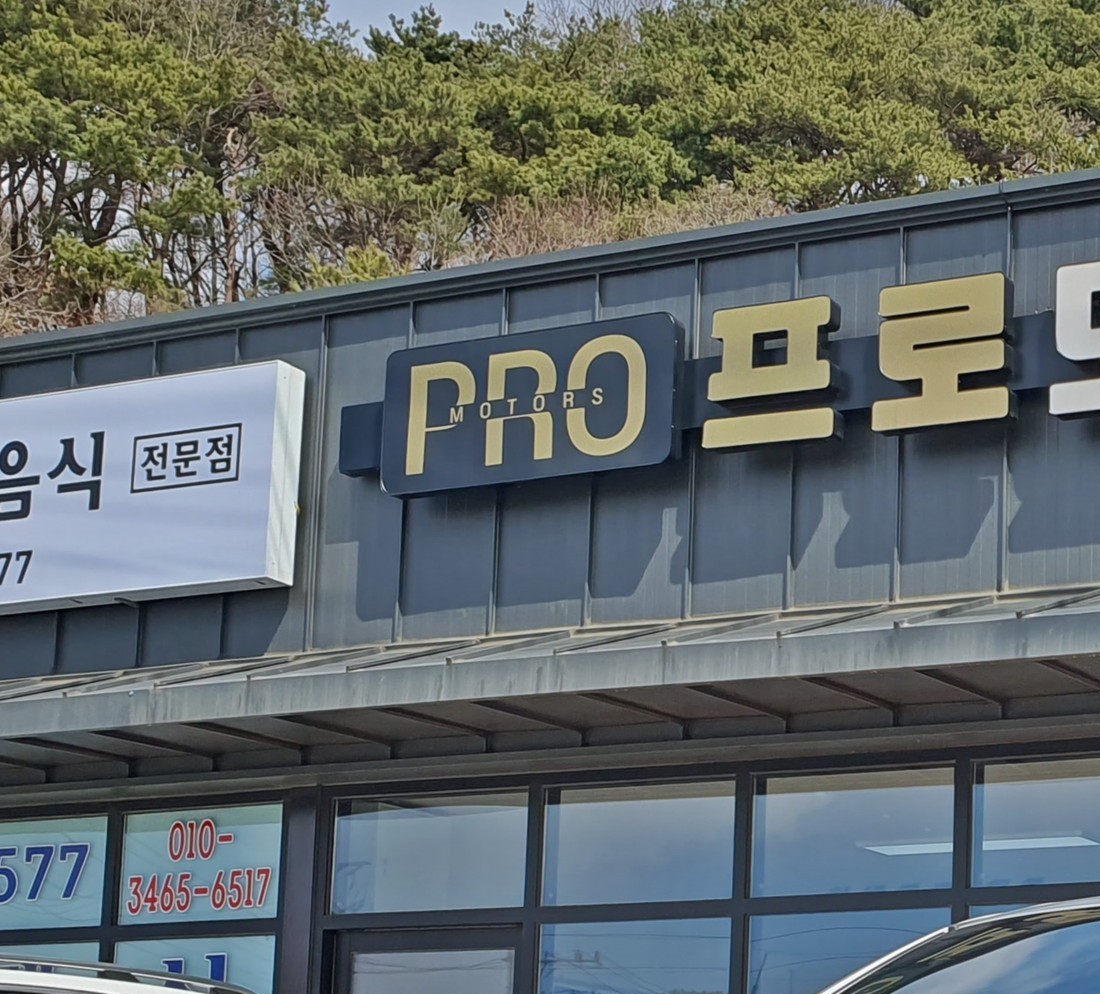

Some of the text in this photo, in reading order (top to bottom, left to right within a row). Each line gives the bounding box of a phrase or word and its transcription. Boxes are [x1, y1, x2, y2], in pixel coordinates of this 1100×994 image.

[405, 334, 647, 476] PRO
[449, 387, 604, 425] MOTORS
[140, 433, 234, 482] 전문점
[168, 818, 234, 863] 010-
[127, 867, 272, 916] 3465-6517
